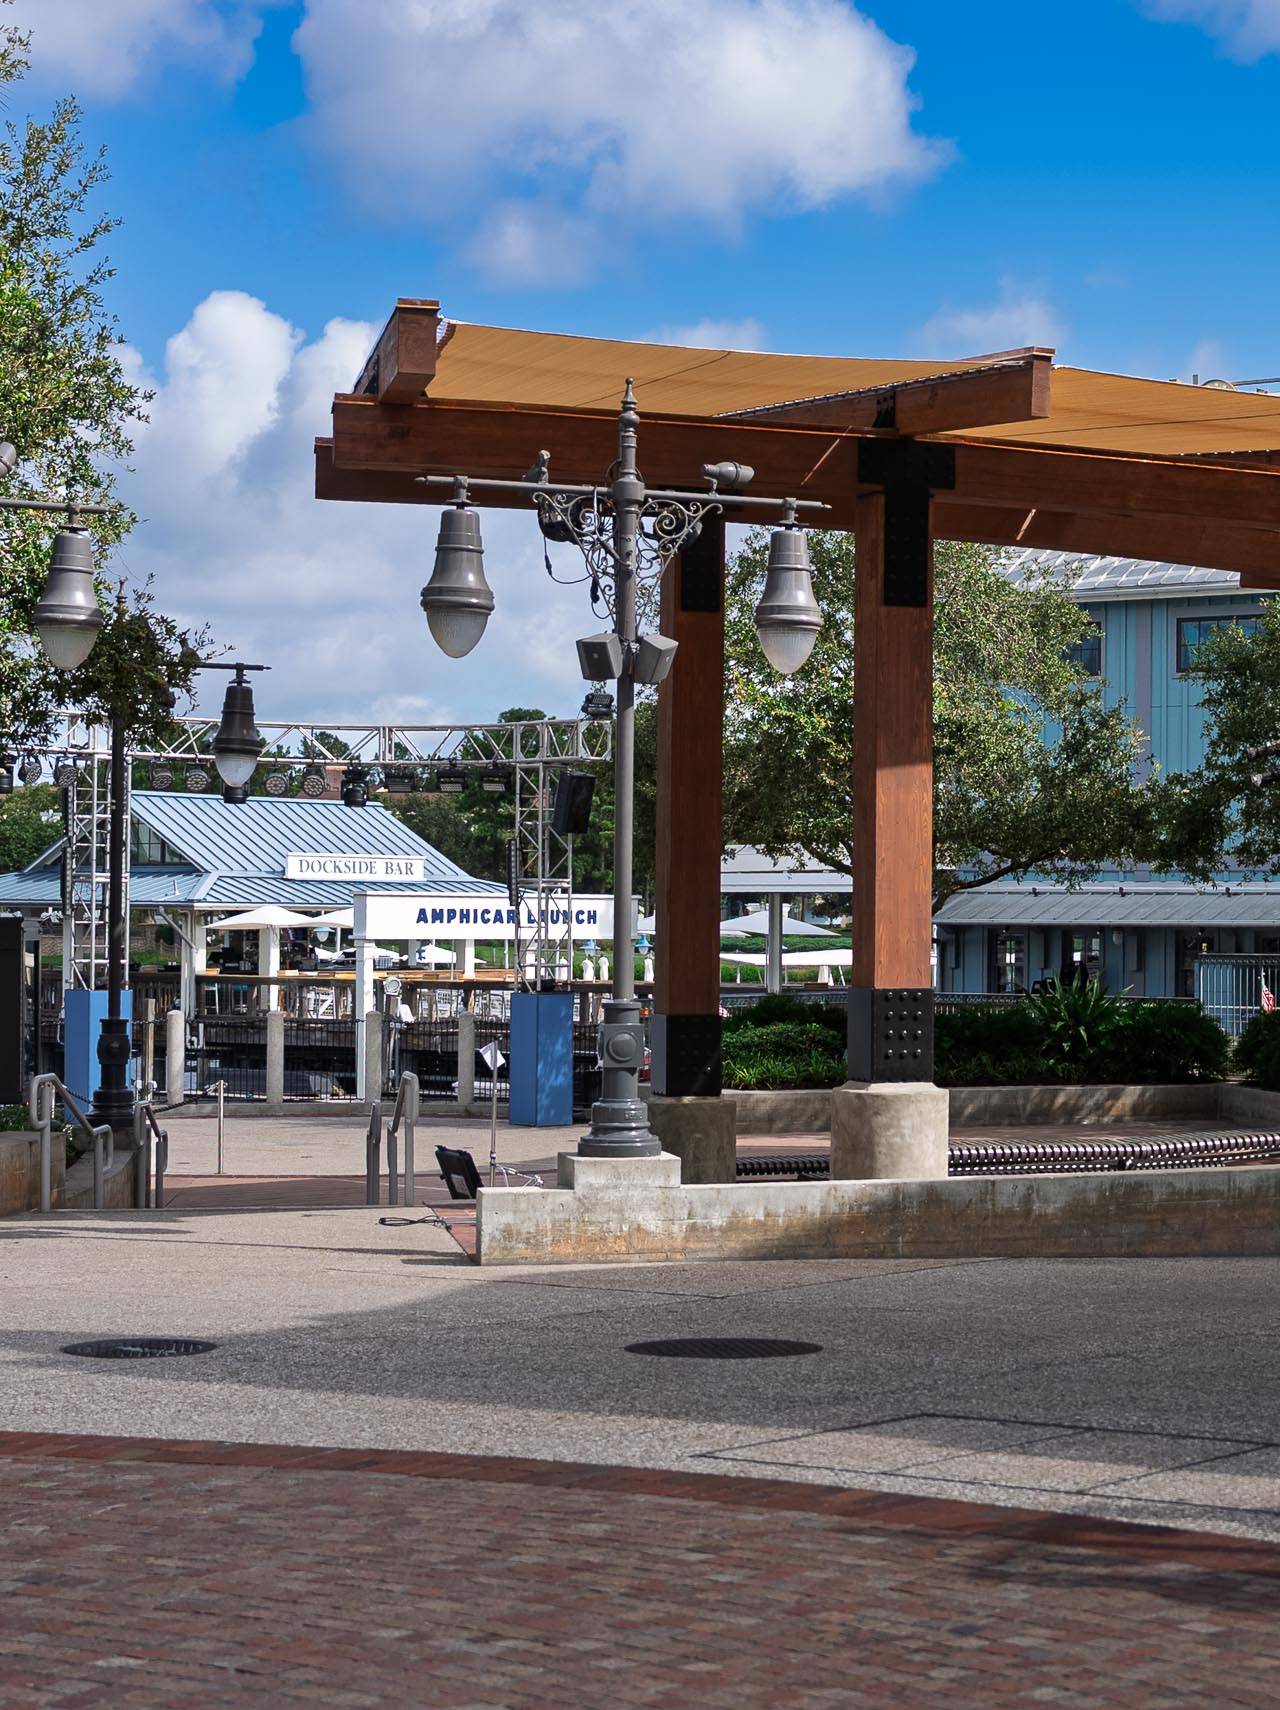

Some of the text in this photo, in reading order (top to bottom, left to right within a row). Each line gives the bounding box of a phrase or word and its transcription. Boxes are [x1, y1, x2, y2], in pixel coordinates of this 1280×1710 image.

[299, 859, 414, 875] DOCKSIDE BAR
[416, 908, 518, 924] AMPHICAR
